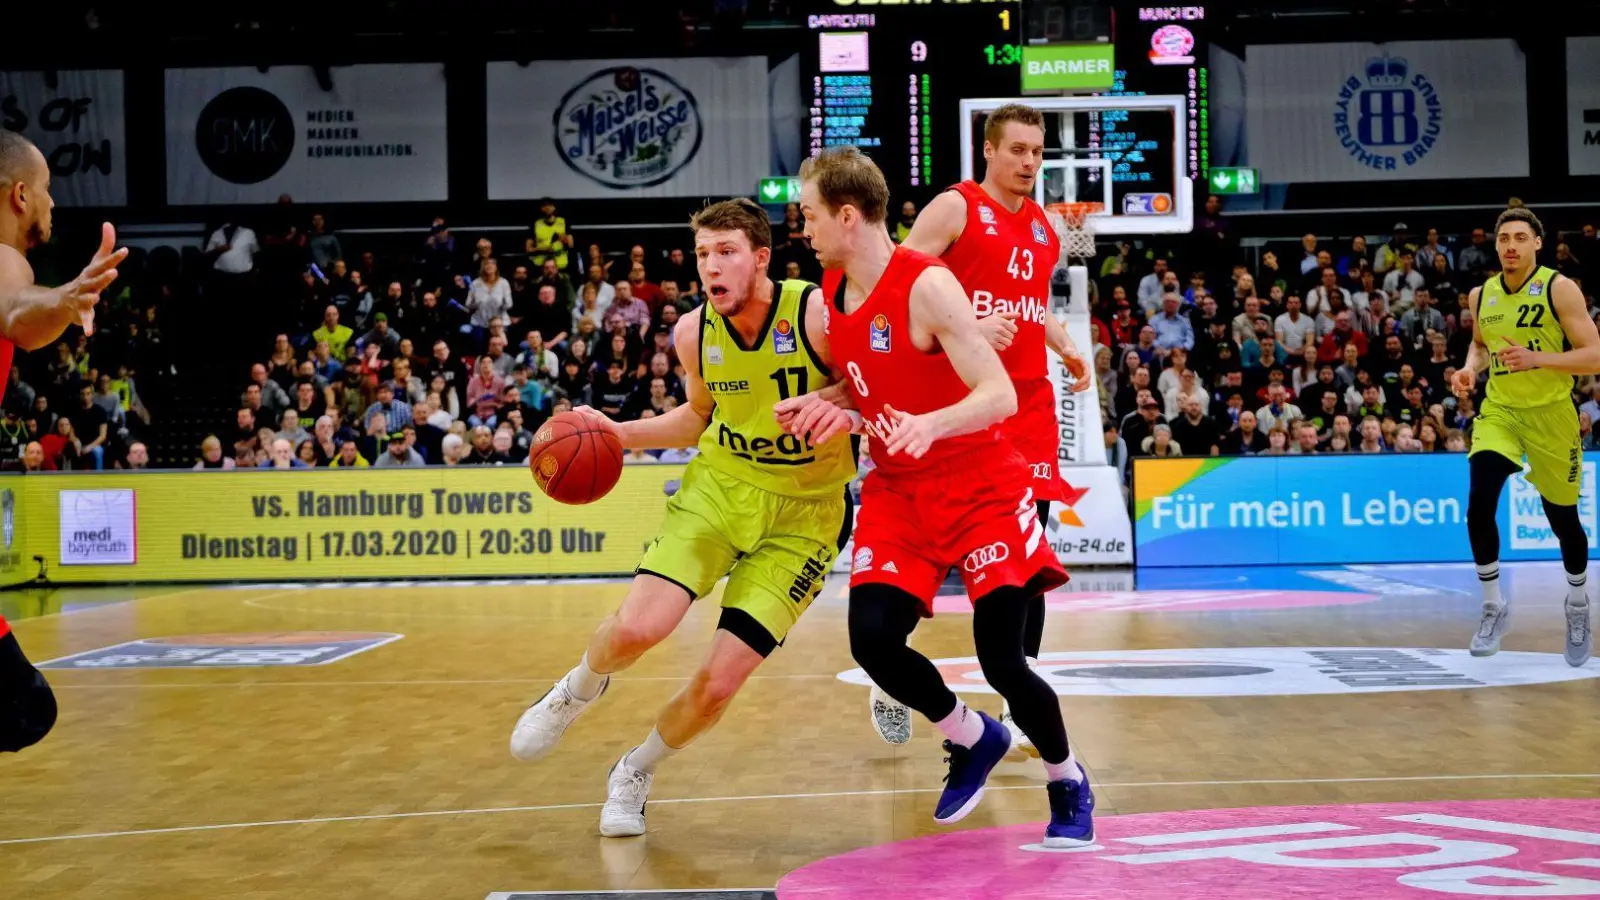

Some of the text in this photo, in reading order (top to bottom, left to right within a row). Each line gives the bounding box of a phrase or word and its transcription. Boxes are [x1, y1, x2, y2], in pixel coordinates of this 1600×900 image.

[998, 10, 1010, 30] 1
[910, 40, 928, 62] 9
[1027, 59, 1110, 75] BARMER
[40, 97, 92, 132] OF
[1333, 75, 1396, 171] BAYREUTHER
[1402, 73, 1444, 167] BRAUHAUS
[211, 116, 279, 155] GMK
[1006, 246, 1034, 280] 43
[1516, 303, 1545, 328] 22
[769, 366, 808, 401] 17
[847, 361, 869, 397] 8
[252, 487, 533, 519] vs. Hamburg Towers
[1152, 491, 1468, 530] Für mein Leben.
[68, 539, 127, 556] bayreuth
[74, 526, 111, 541] medi
[182, 532, 298, 561] Dienstag
[320, 529, 458, 557] 17.03.2020
[480, 528, 553, 555] 20:30
[560, 527, 606, 553] Uhr
